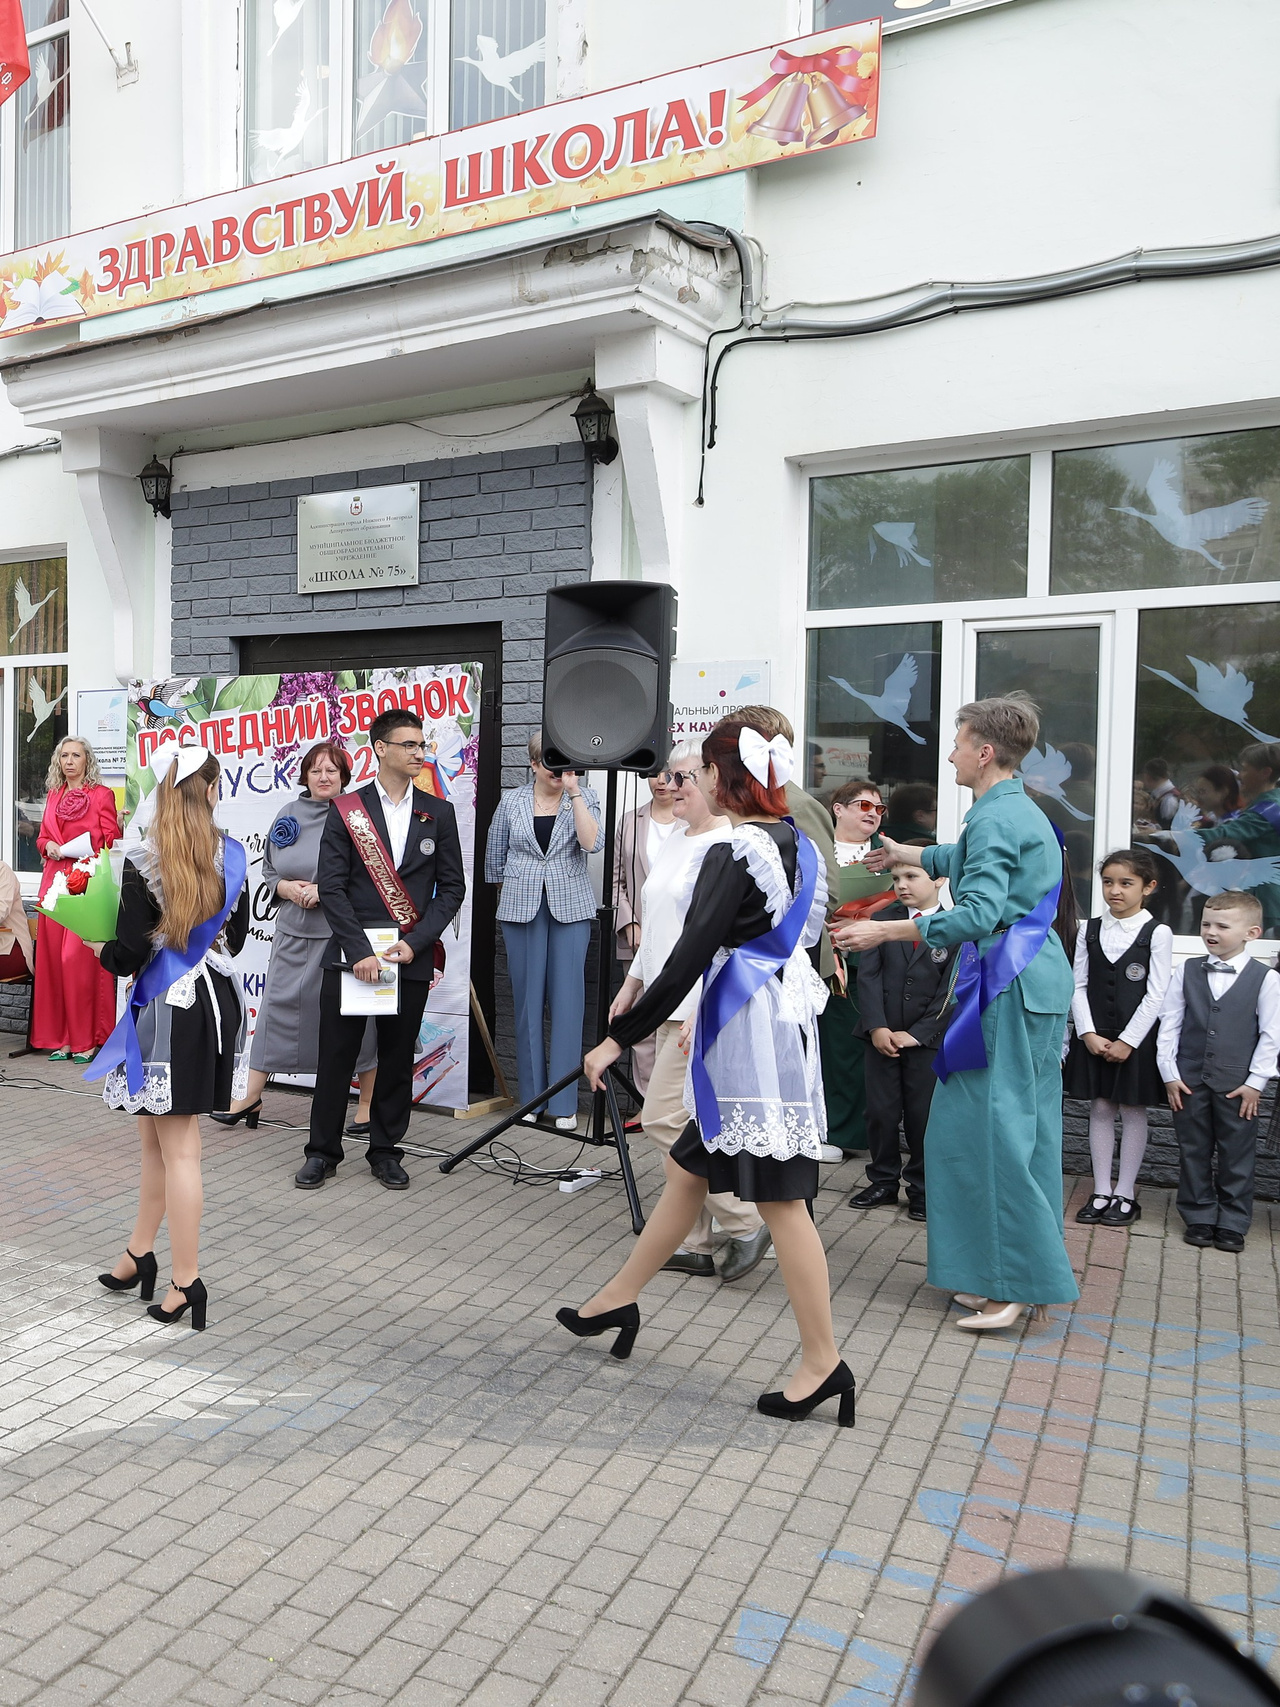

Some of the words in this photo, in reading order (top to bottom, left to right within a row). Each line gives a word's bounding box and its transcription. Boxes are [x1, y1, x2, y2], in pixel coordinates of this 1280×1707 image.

[96, 162, 422, 297] ЗДРАВСТВУЙ,
[443, 89, 732, 208] ШКОЛА!
[364, 535, 406, 545] БЮДЖЕТНОЕ
[335, 552, 377, 561] УЧРЕЖДЕНИЕ
[308, 568, 365, 583] «ШКОЛА
[369, 566, 384, 578] №
[388, 565, 406, 577] 75»
[339, 676, 470, 734] ЗВОНОК
[385, 890, 417, 925] 2025
